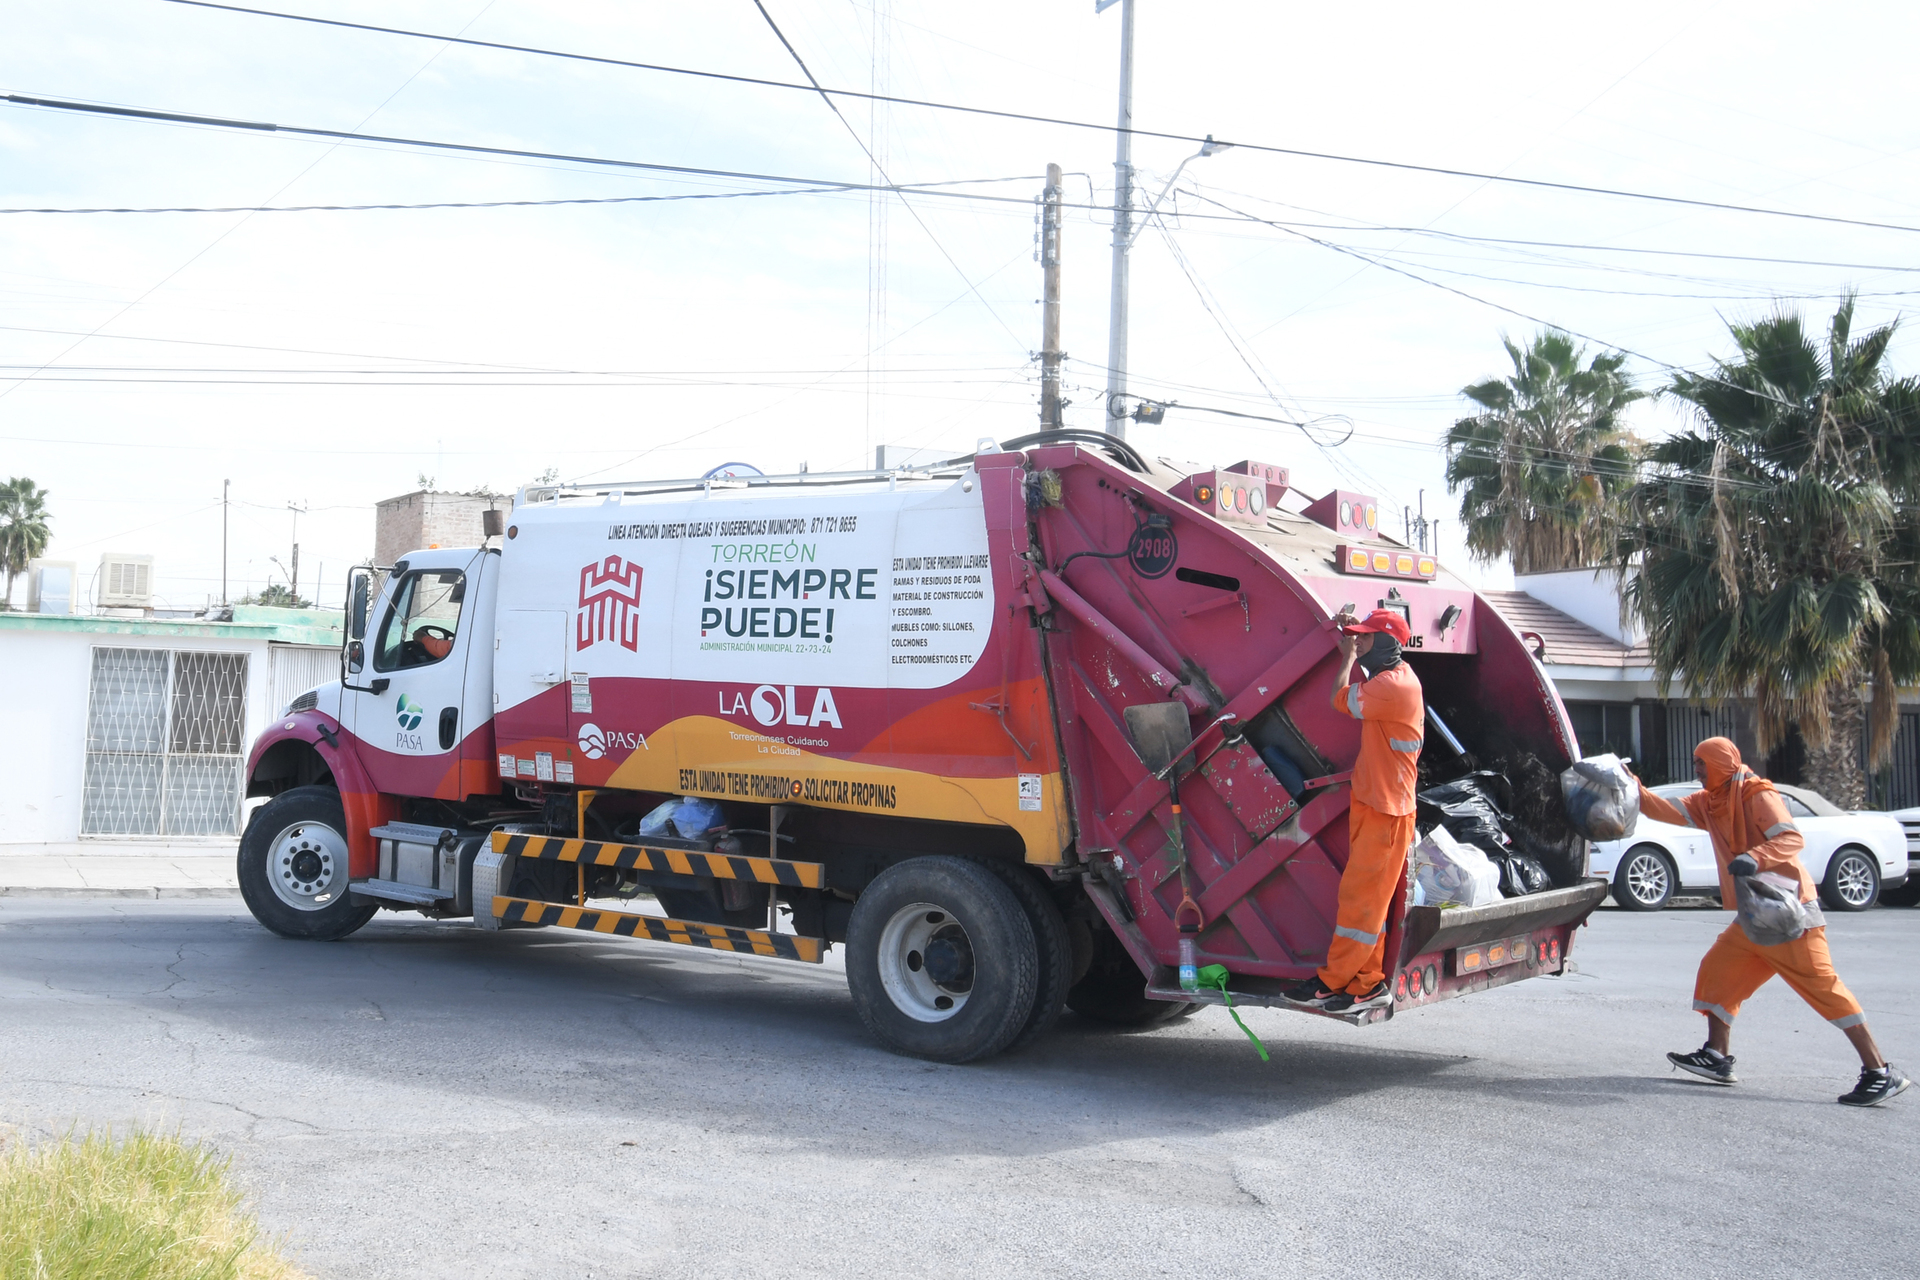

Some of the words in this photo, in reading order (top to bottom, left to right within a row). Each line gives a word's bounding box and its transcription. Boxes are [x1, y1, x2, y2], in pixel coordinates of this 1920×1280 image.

[608, 525, 627, 540] LINEA
[627, 520, 660, 540] ATENCIÓN
[661, 523, 687, 539] DIRECTA
[688, 522, 713, 538] QUEJAS
[714, 522, 721, 537] Y
[720, 519, 767, 537] SUGERENCIAS
[767, 518, 806, 535] MUNICIPIO:
[810, 517, 824, 533] 871
[825, 516, 838, 533] 721
[839, 515, 857, 533] 8655
[711, 539, 816, 563] TORREÓN
[1136, 538, 1170, 558] 2908
[893, 558, 904, 571] ESTA
[904, 557, 922, 571] UNIDAD
[923, 557, 937, 570] TIENE
[937, 556, 963, 570] PROHIBIDO
[963, 554, 988, 569] LLEVARSE
[704, 568, 878, 602] ¡SIEMPRE
[893, 577, 914, 586] RAMAS
[915, 577, 921, 585] Y
[921, 576, 952, 586] RESIDUOS
[953, 575, 962, 584] DE
[963, 575, 981, 584] PODA
[892, 592, 922, 601] MATERIAL
[923, 592, 932, 600] DE
[933, 589, 984, 600] CONSTRUCCIÓN
[892, 608, 897, 616] Y
[898, 607, 932, 617] ESCOMBRO.
[701, 607, 835, 643] PUEDE!
[891, 623, 919, 632] MUEBLES
[920, 623, 941, 631] COMO:
[942, 622, 975, 632] SILLONES,
[700, 641, 755, 652] ADMINISTRACIÓN
[757, 643, 793, 653] MUNICIPAL
[891, 638, 928, 647] COLCHONES
[891, 653, 959, 664] ELECTRODOMÉSTICOS
[960, 655, 975, 664] ETC.
[719, 691, 749, 716] LA
[396, 732, 423, 752] PASA
[606, 731, 649, 751] PASA
[729, 731, 785, 744] Torreonenses
[787, 735, 829, 747] Cuidando
[757, 744, 769, 754] La
[770, 745, 801, 756] Ciudad
[679, 768, 698, 791] ESTA
[699, 770, 726, 793] UNIDAD
[727, 772, 749, 796] TIENE
[750, 774, 790, 799] PROHIBIDO
[804, 778, 849, 803] SOLICITAR
[851, 782, 896, 809] PROPINAS
